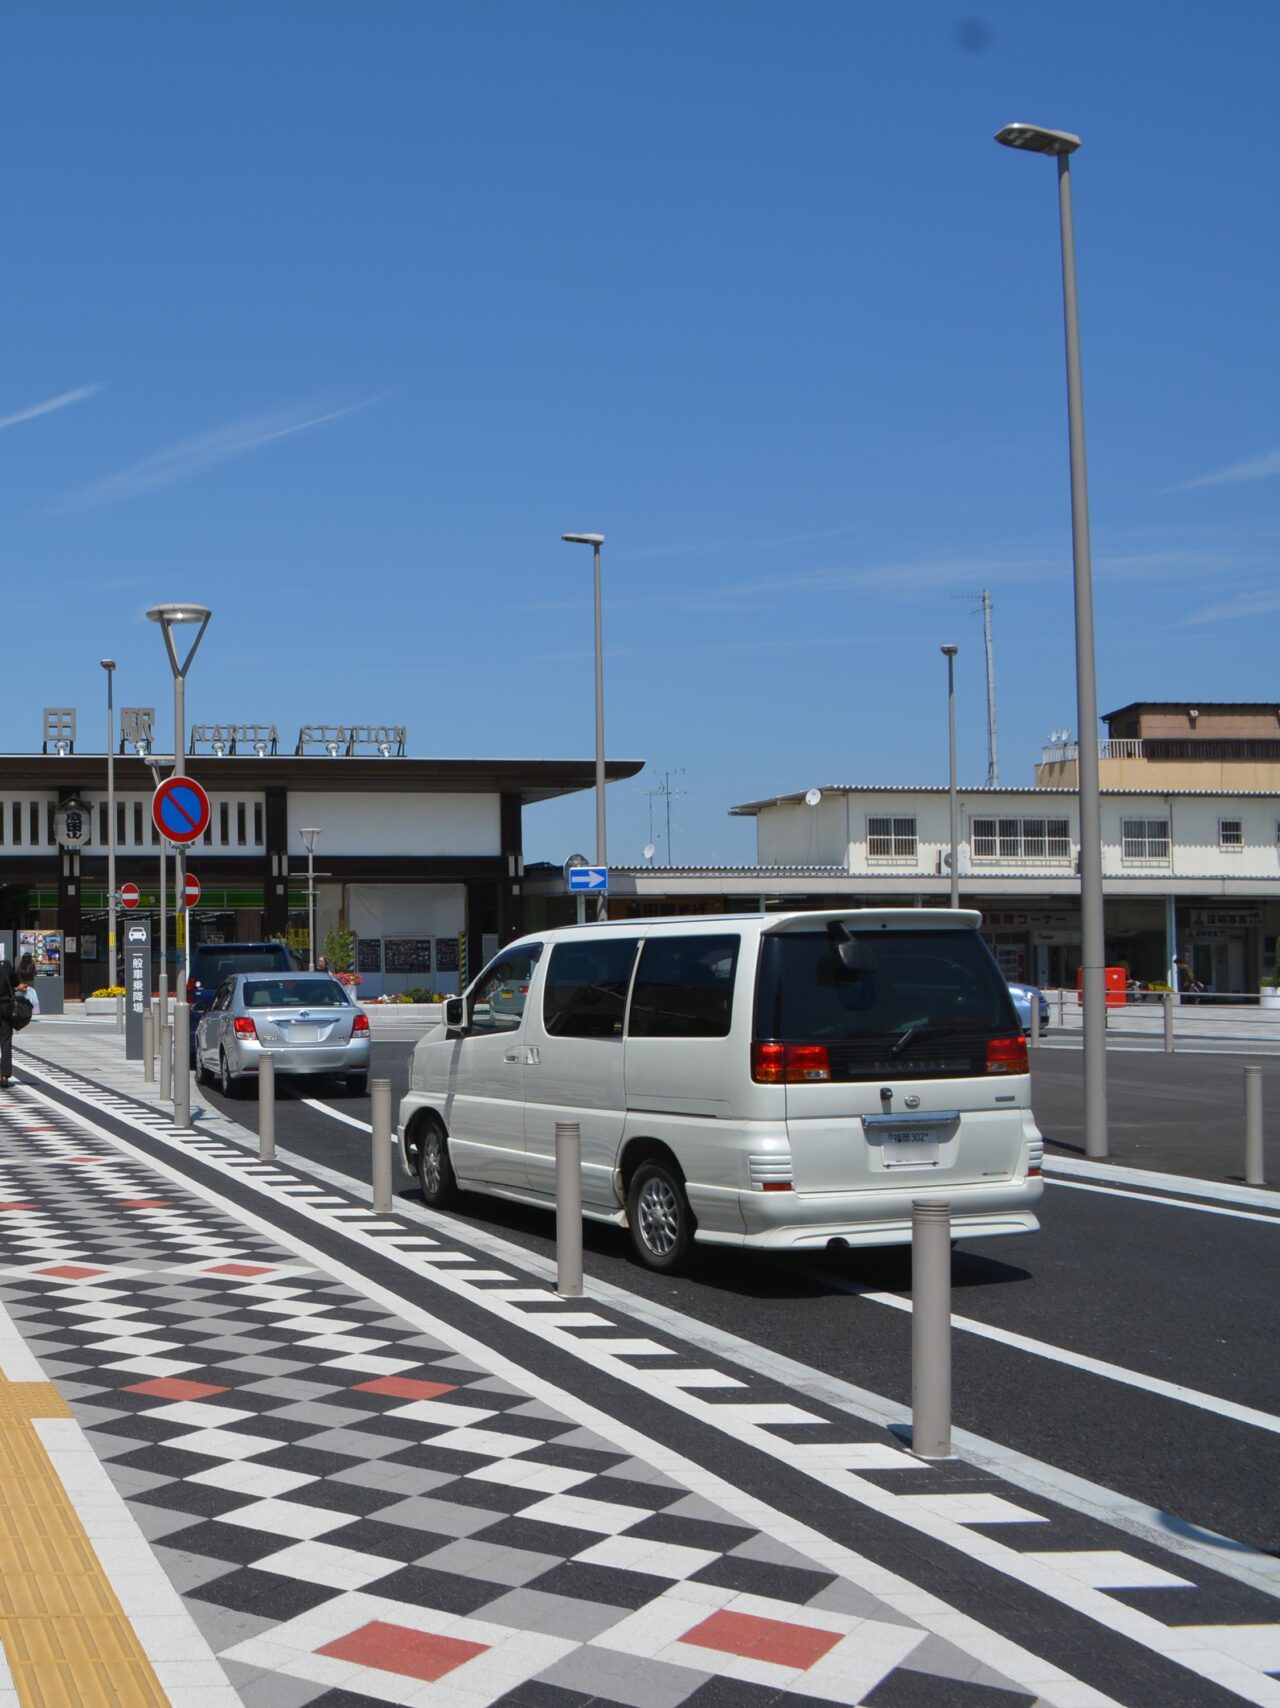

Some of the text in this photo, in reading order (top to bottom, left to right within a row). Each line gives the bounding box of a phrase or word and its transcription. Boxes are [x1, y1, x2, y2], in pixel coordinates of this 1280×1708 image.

[192, 724, 280, 743] NARITA
[301, 725, 407, 744] STATION
[132, 952, 144, 1013] 一般車乗降場
